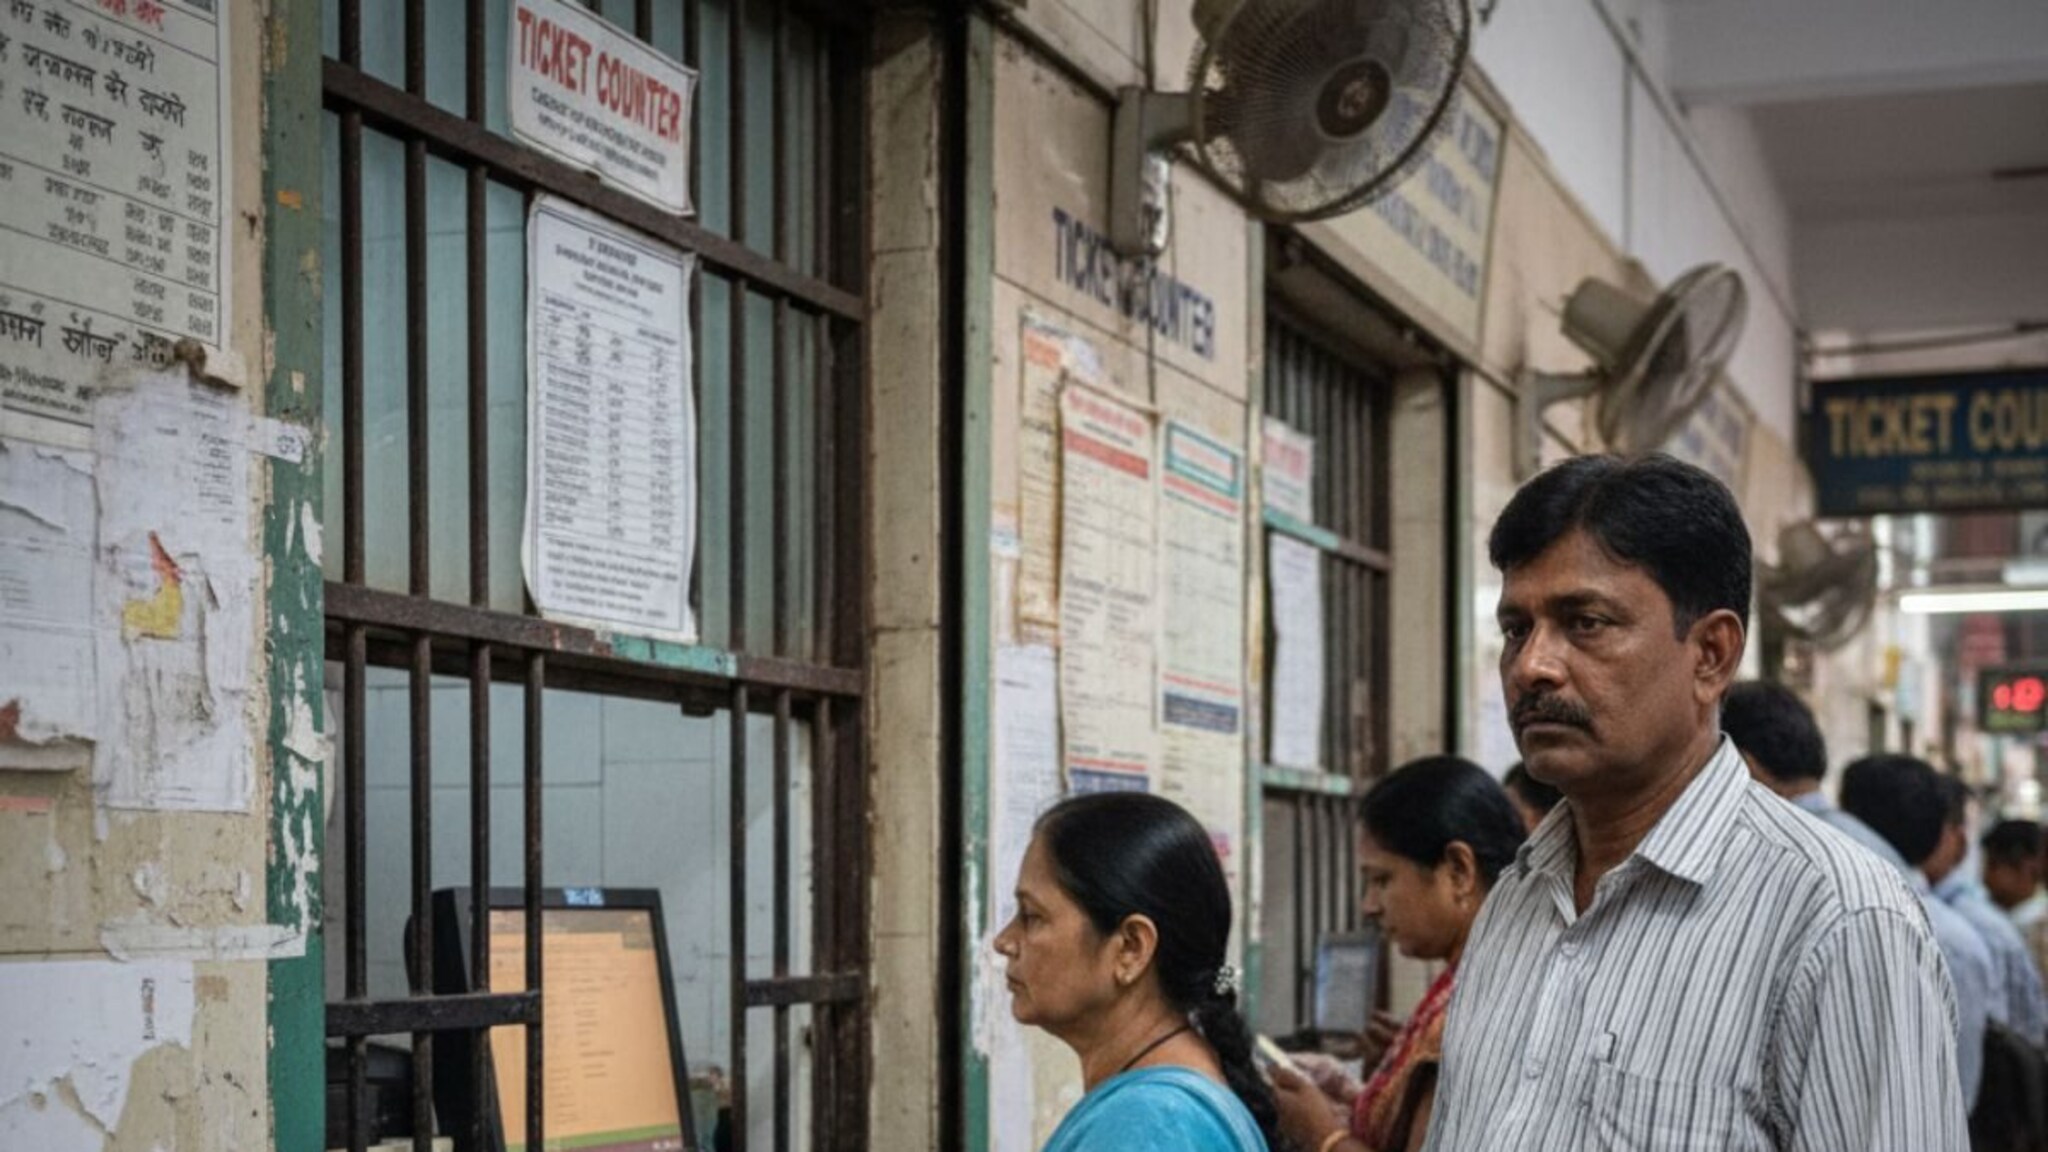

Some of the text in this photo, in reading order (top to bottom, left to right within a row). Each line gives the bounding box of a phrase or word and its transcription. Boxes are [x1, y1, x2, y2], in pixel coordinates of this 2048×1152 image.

[517, 6, 592, 95] TICKET
[596, 51, 681, 144] COUNTER
[1827, 395, 1956, 456] TICKET
